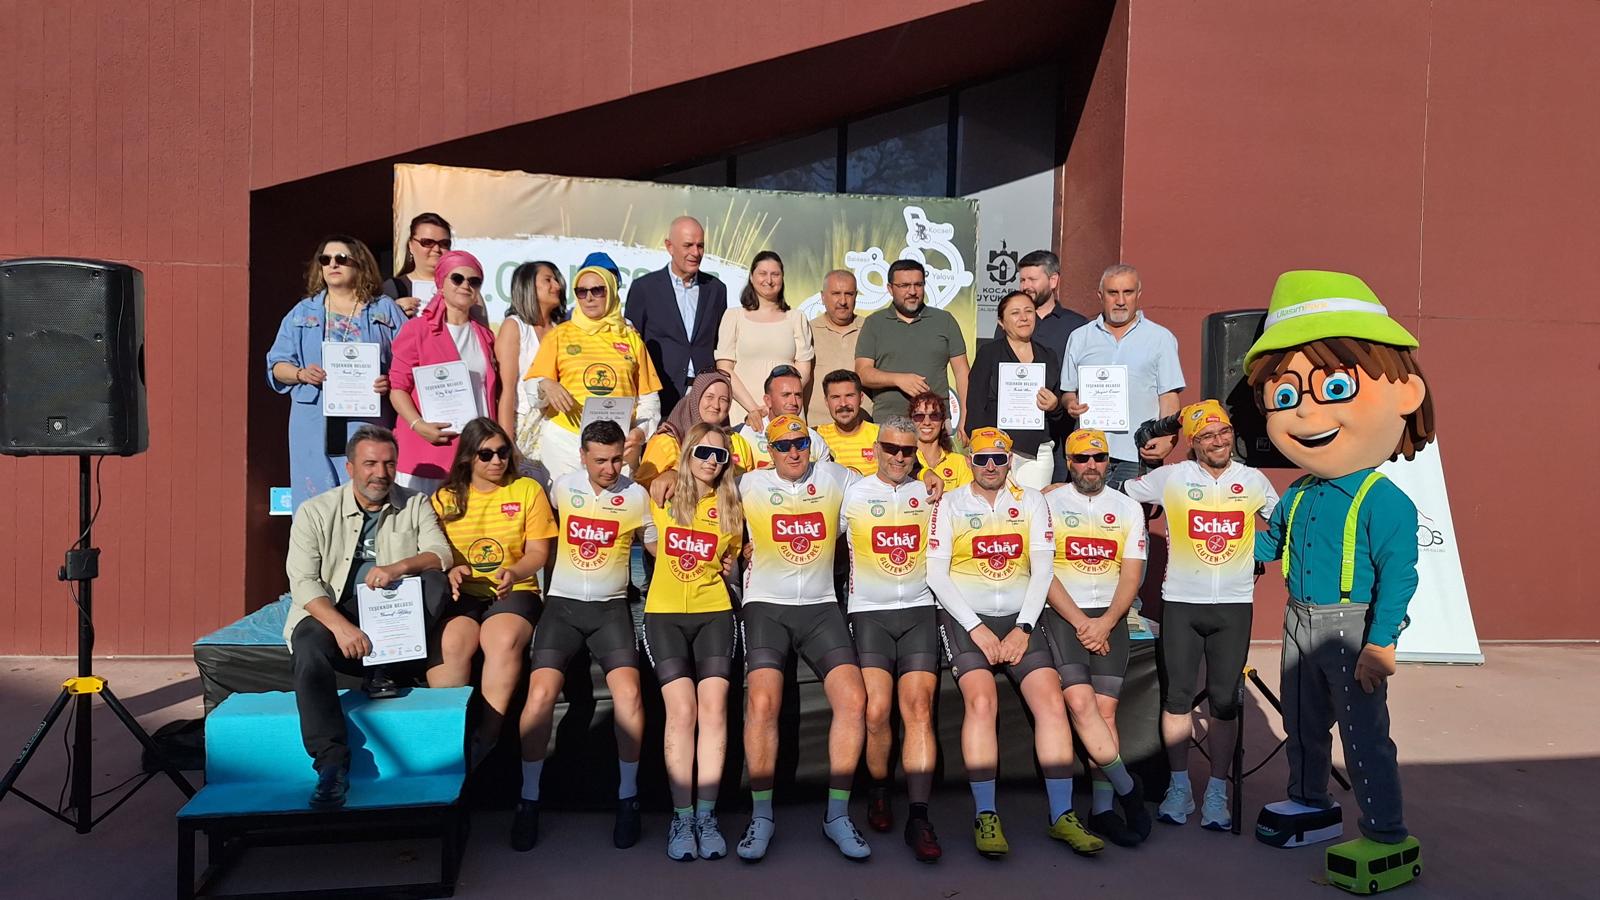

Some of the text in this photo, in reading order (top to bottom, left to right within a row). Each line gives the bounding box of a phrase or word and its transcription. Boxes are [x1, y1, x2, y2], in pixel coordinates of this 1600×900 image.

[928, 226, 953, 234] Kocaeli
[932, 272, 955, 281] Yalova
[930, 500, 940, 536] KOBIDO
[1193, 516, 1240, 536] Schär
[569, 521, 614, 544] Schär
[776, 519, 821, 538] Schär
[668, 532, 713, 558] Schär
[876, 531, 917, 549] Schär
[977, 540, 1019, 556] Schär
[570, 548, 608, 568] GLUTEN-FREE
[780, 545, 820, 562] GLUTEN-FREE
[1070, 542, 1113, 558] Schär
[1195, 543, 1236, 562] GLUTEN-FREE
[879, 556, 916, 573] GLUTEN-FREE
